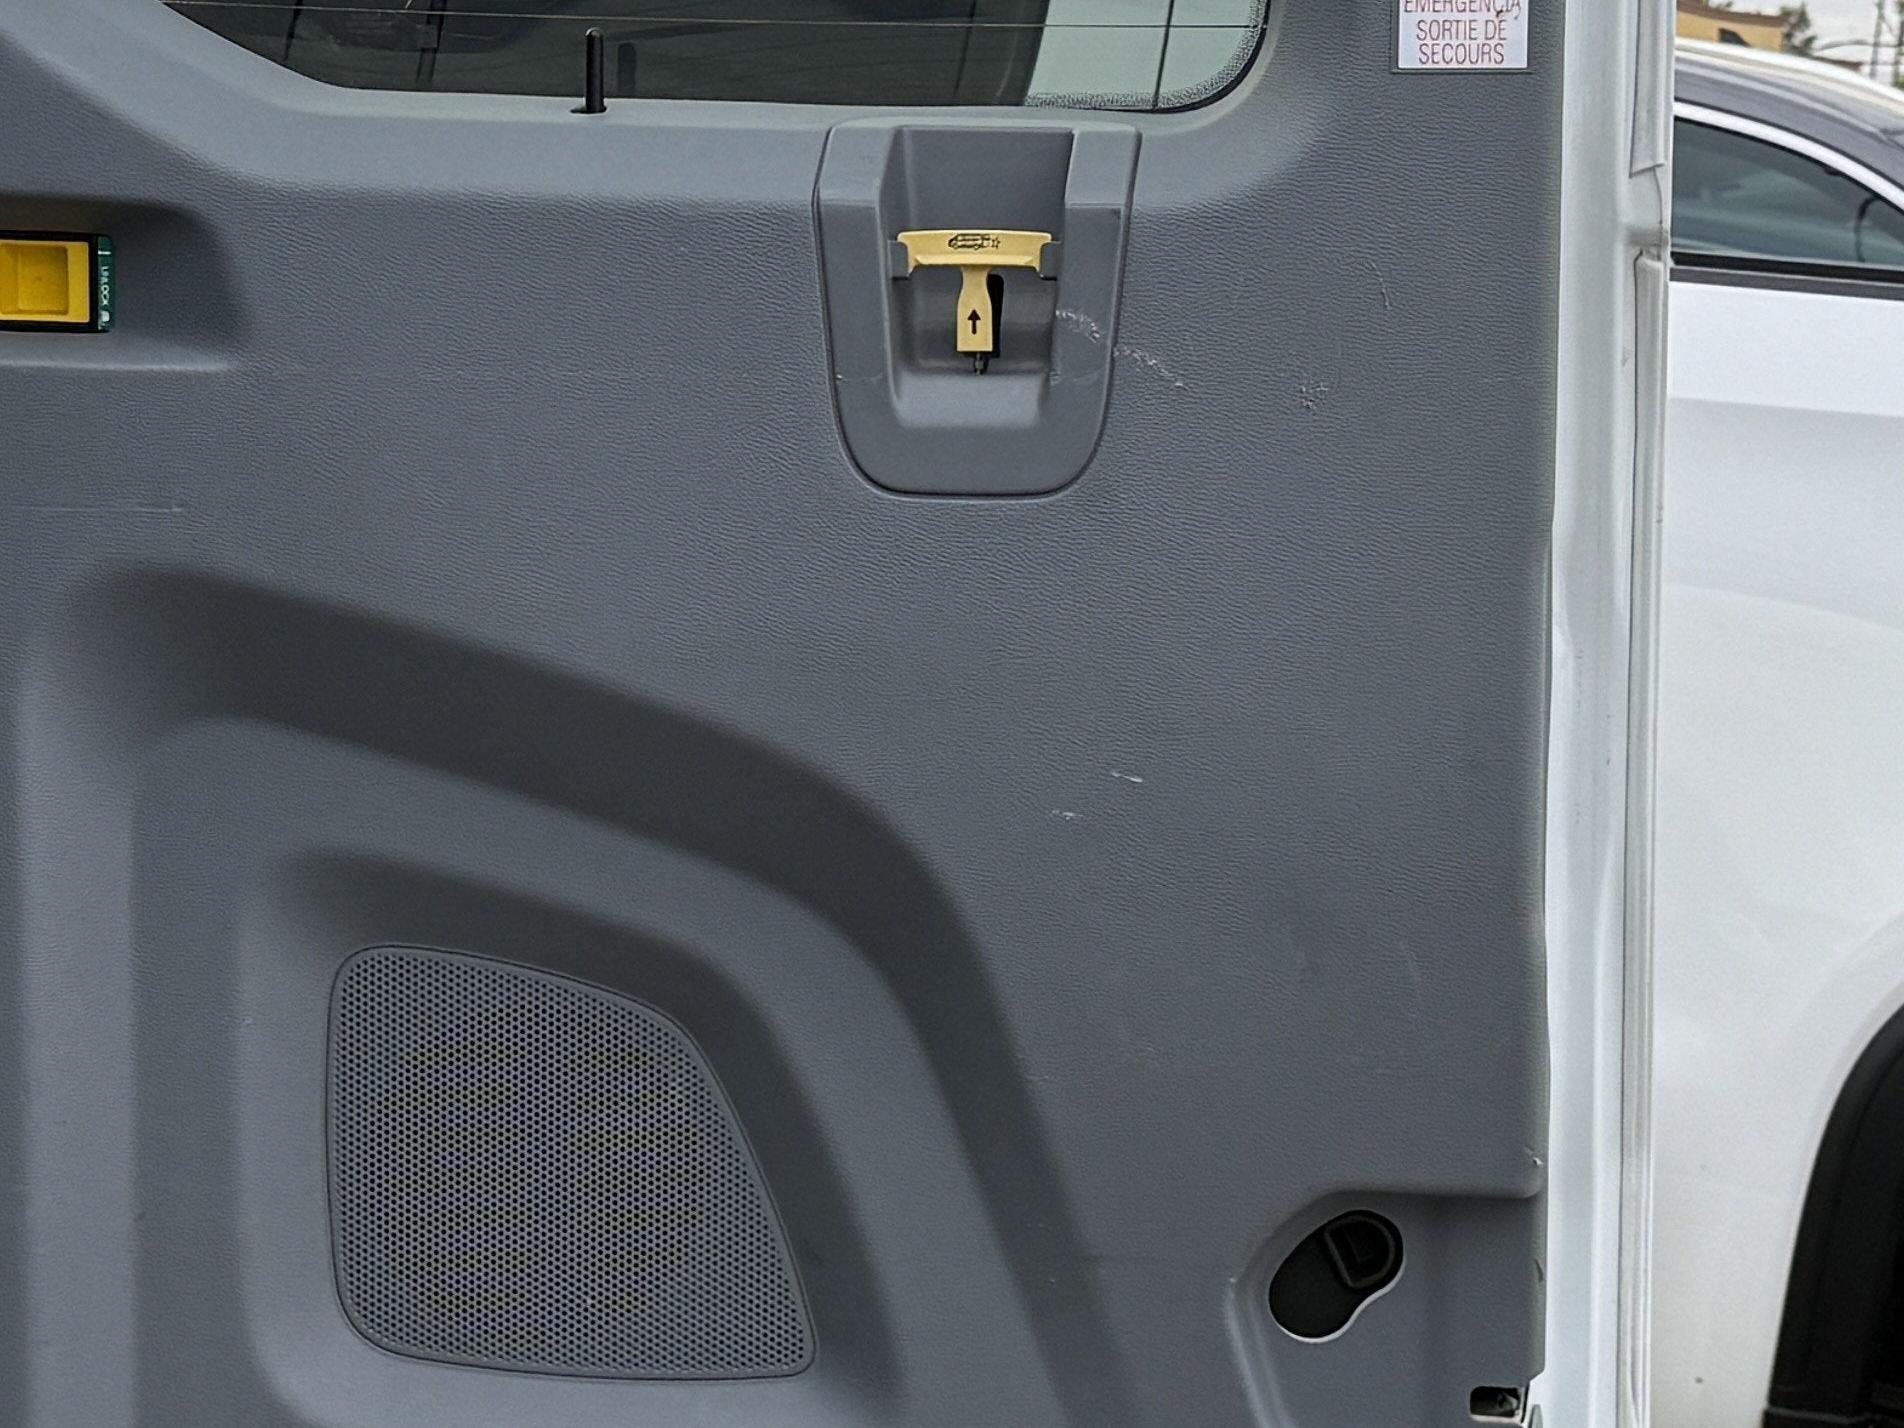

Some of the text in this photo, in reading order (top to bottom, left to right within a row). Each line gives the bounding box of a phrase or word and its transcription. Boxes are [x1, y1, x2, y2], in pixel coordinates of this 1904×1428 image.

[1416, 19, 1507, 42] SORTIE DE
[1418, 42, 1505, 65] SECOURS
